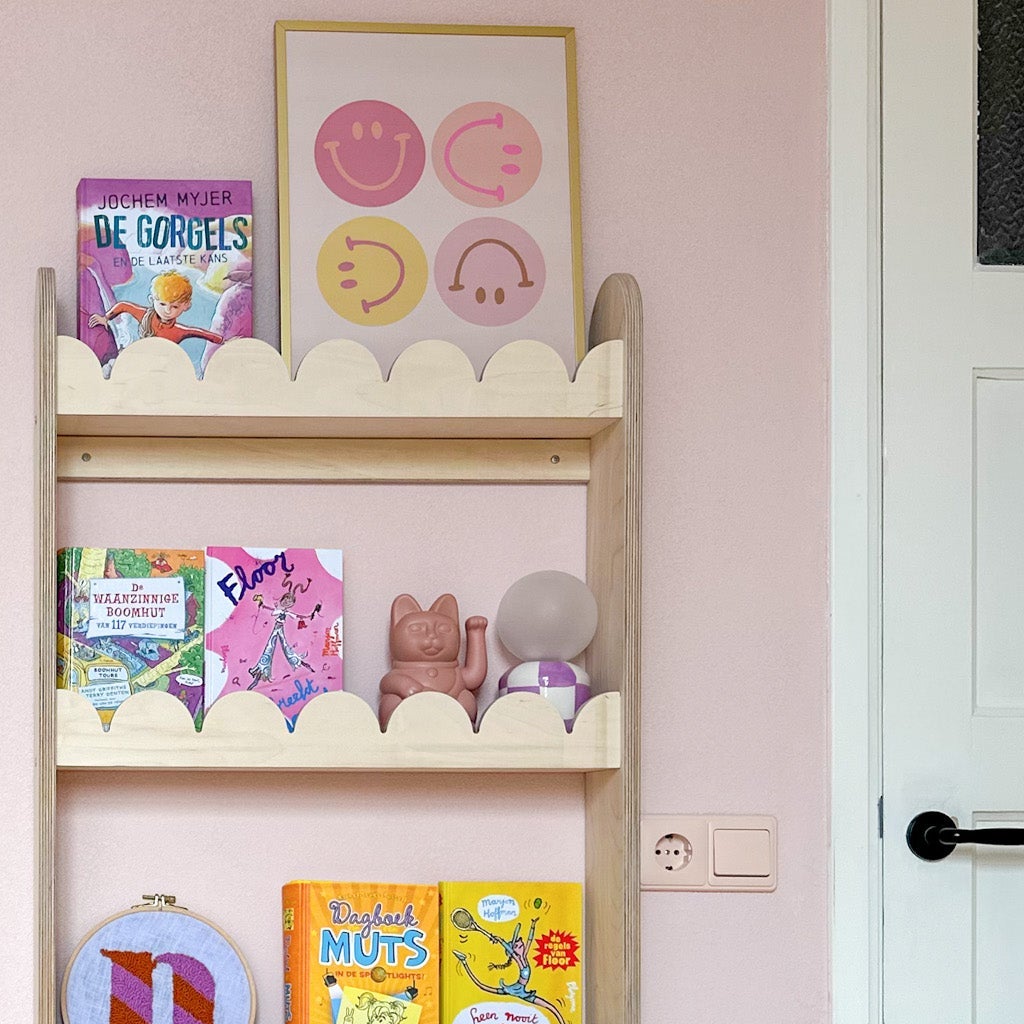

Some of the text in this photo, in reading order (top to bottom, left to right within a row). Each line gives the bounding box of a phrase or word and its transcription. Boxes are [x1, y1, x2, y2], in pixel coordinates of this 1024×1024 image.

[98, 190, 233, 210] JOCHEM MYJER
[93, 214, 249, 250] DE GORGELS
[113, 253, 228, 267] EN DE LAATSTE KANS
[217, 551, 295, 607] Floor
[93, 593, 179, 604] WAANZINNIGE
[106, 606, 166, 618] BOOMHUT
[111, 619, 127, 630] 117
[329, 900, 418, 939] Dagboek
[320, 929, 428, 967] MUTS
[543, 942, 571, 951] regels
